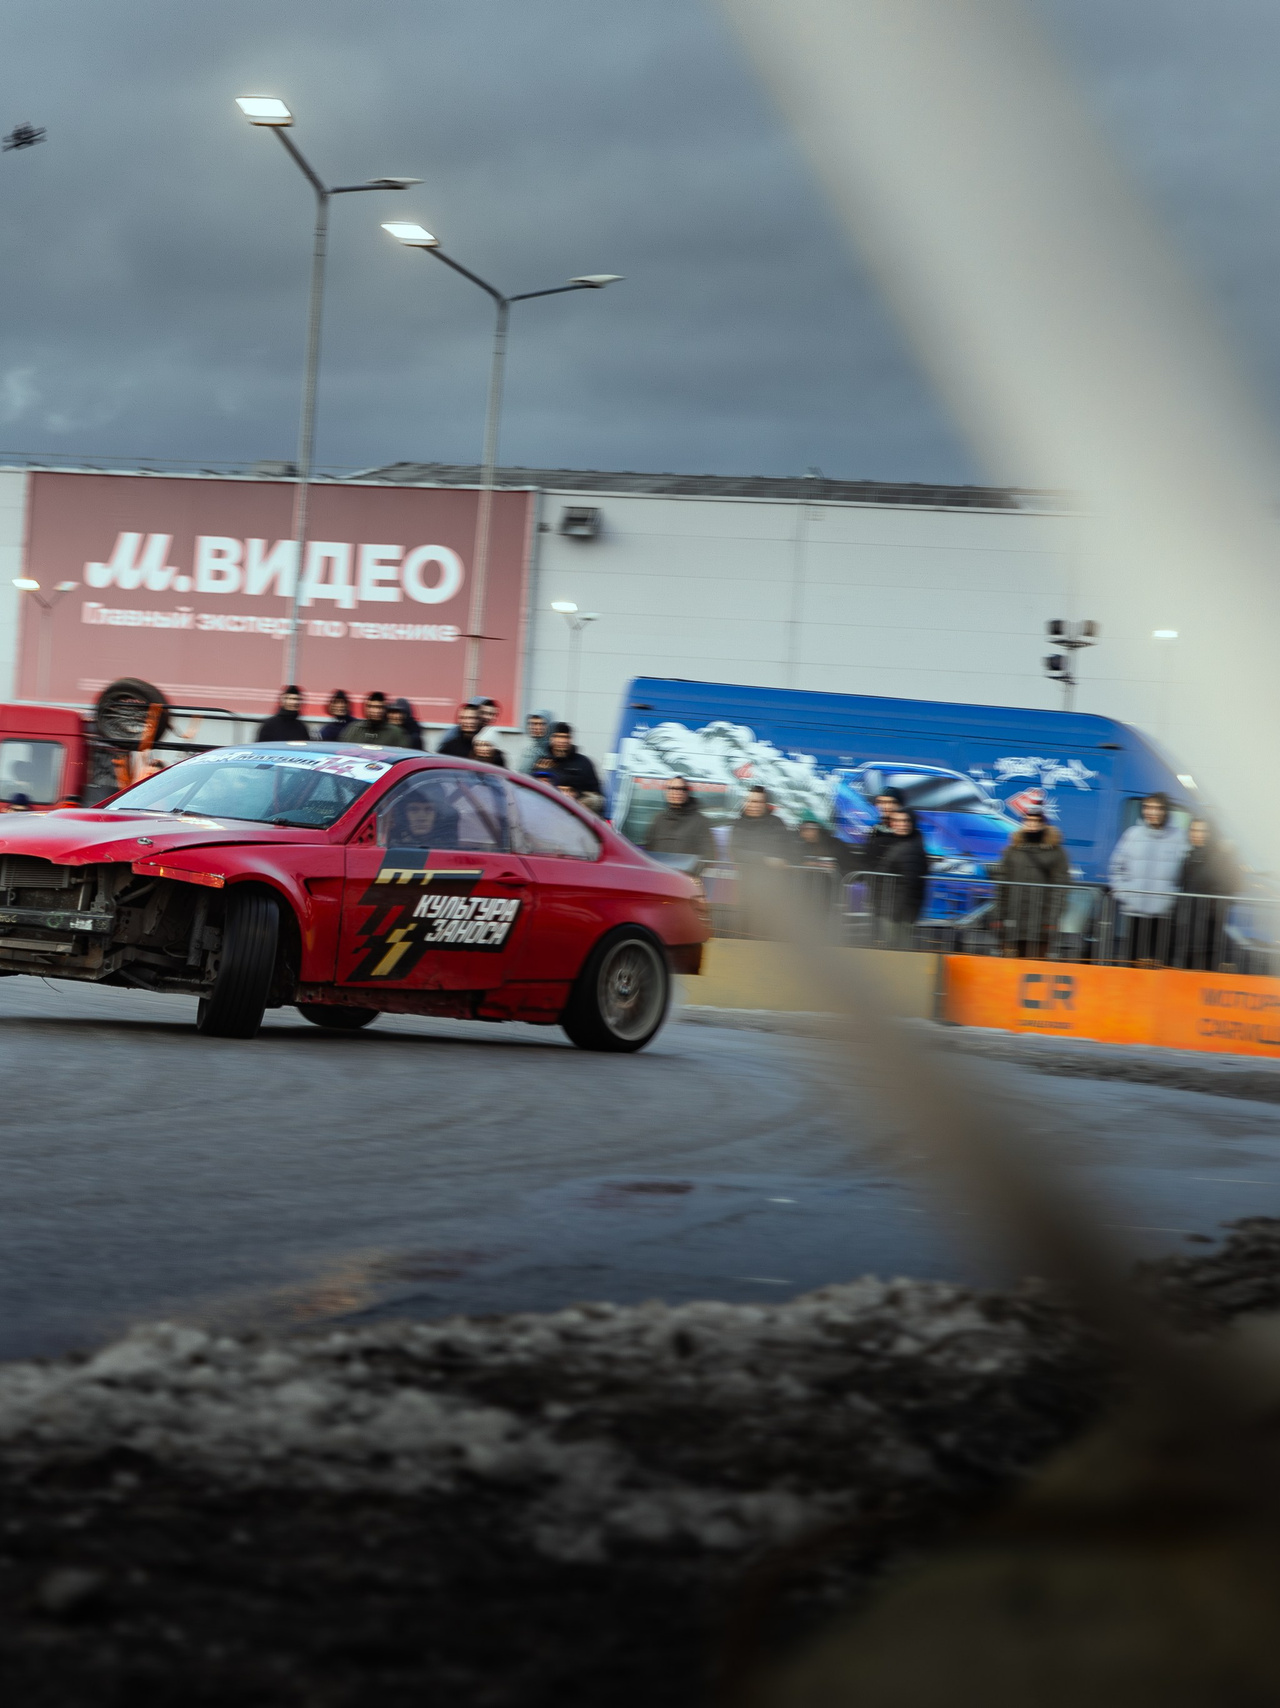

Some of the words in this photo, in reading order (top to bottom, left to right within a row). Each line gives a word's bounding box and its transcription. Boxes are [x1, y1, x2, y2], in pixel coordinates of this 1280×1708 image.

[81, 602, 195, 629] Главный
[307, 619, 348, 638] по
[349, 621, 461, 642] технике
[413, 895, 521, 921] КУЛЬТУРА
[424, 919, 512, 944] ЗАНОСА
[1019, 973, 1075, 1010] CR
